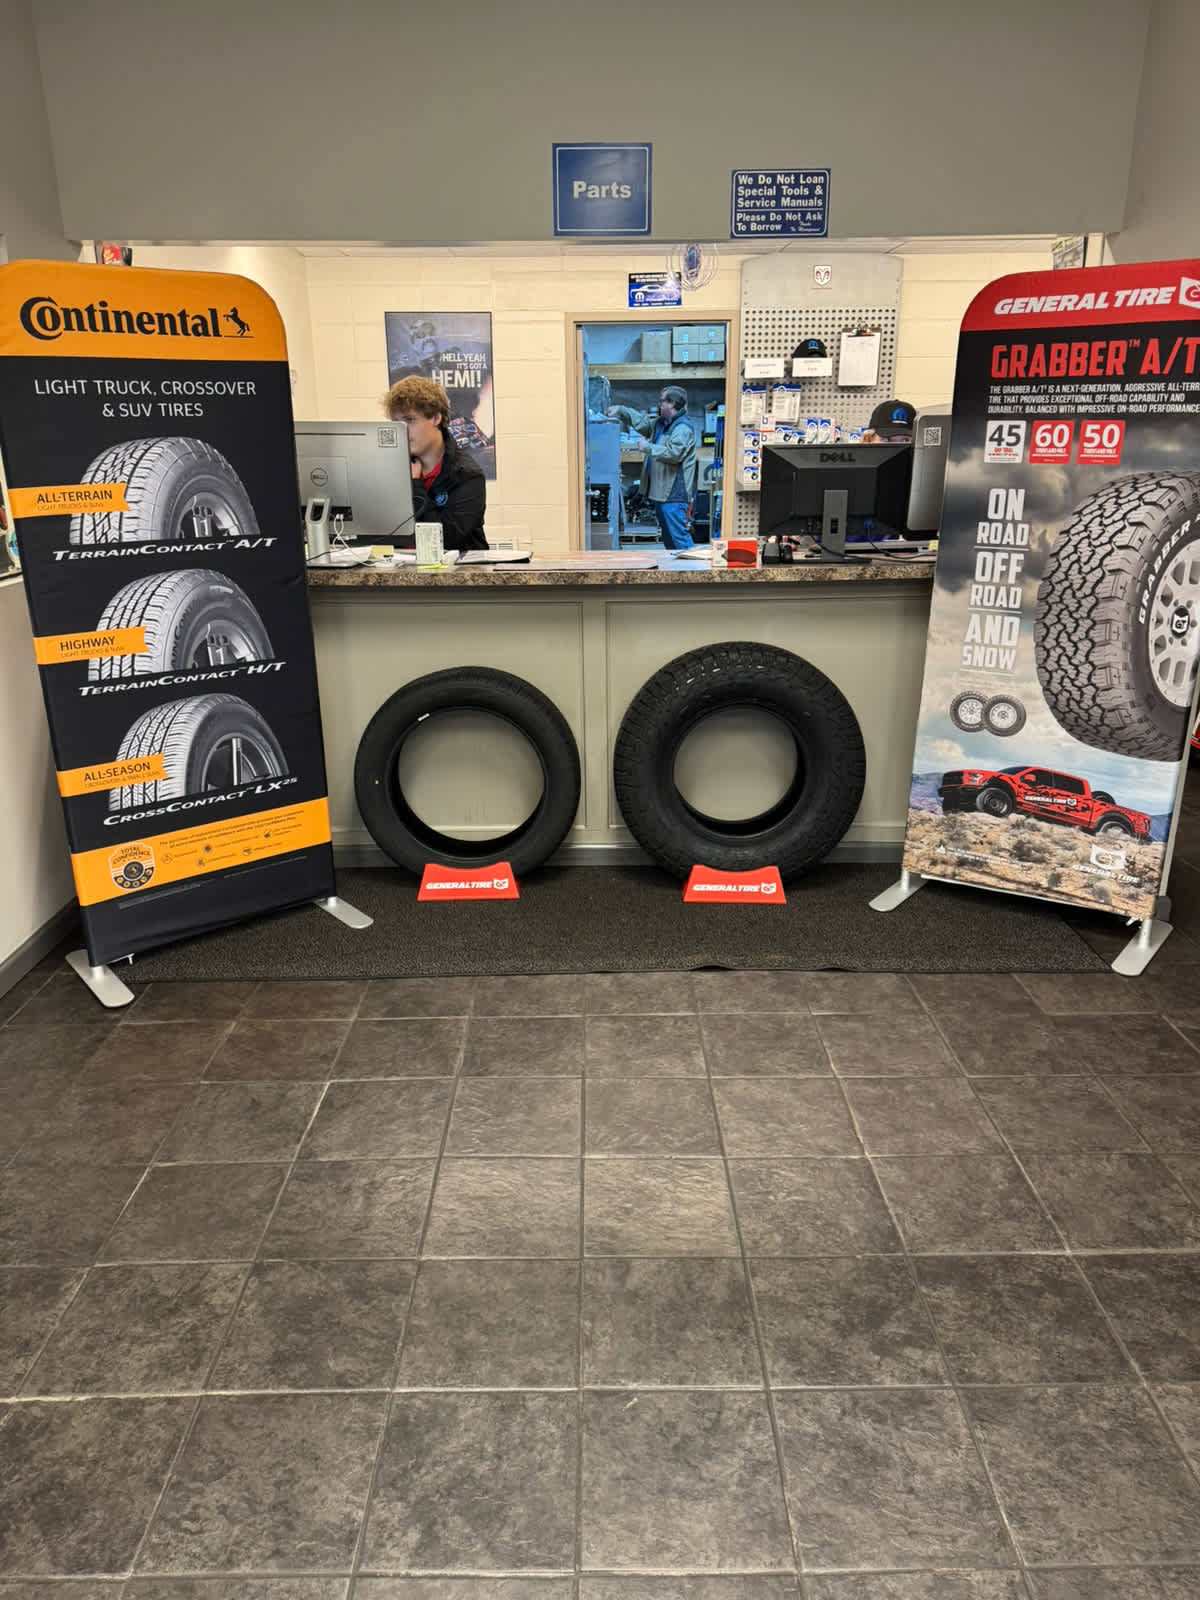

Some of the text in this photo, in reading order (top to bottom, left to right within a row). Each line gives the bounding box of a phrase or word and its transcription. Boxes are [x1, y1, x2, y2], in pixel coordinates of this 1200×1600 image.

[738, 174, 824, 184] We Do Not Loan
[573, 181, 632, 199] Parts
[737, 185, 823, 197] Special Tools &
[737, 197, 823, 207] Service Manuals
[737, 212, 823, 221] Please Do Not Ask
[737, 223, 746, 231] To
[750, 223, 782, 231] Borrow
[994, 286, 1176, 315] GENERAL TIRE
[20, 296, 222, 340] Continental
[442, 353, 486, 362] HELL YEAH
[432, 370, 482, 388] HEMI!
[34, 379, 257, 396] LIGHT TRUCK, CROSSOVER
[990, 386, 1001, 394] THE
[1124, 382, 1166, 392] AGGRESSIVE
[989, 393, 1185, 404] TIRE THAT PROVIDES EXCEPTIONAL OFF-ROAD CAPABILITY AND
[102, 403, 204, 417] & SUV TIRES
[1025, 405, 1057, 413] BALANCED
[1058, 405, 1075, 413] WITH
[1076, 404, 1117, 413] IMPRESSIVE
[1117, 404, 1148, 413] ON-ROAD
[988, 424, 1021, 446] 45
[1035, 424, 1069, 448] 60
[1083, 424, 1120, 448] 50
[819, 452, 856, 463] DELL
[37, 490, 113, 504] ALL-TERRAIN
[987, 488, 1025, 521] ON
[977, 522, 1030, 546] ROAD
[234, 537, 278, 549] A/T
[974, 552, 1025, 584] OFF
[970, 584, 1022, 609] ROAD
[964, 614, 1021, 647] AND
[60, 636, 116, 651] HIGHWAY
[962, 646, 1017, 671] SNOW
[247, 661, 287, 674] H/T
[84, 762, 151, 781] ALL-SEASON
[426, 880, 492, 890] GENERAL TIRE
[693, 883, 760, 893] GENERAL TIRE
